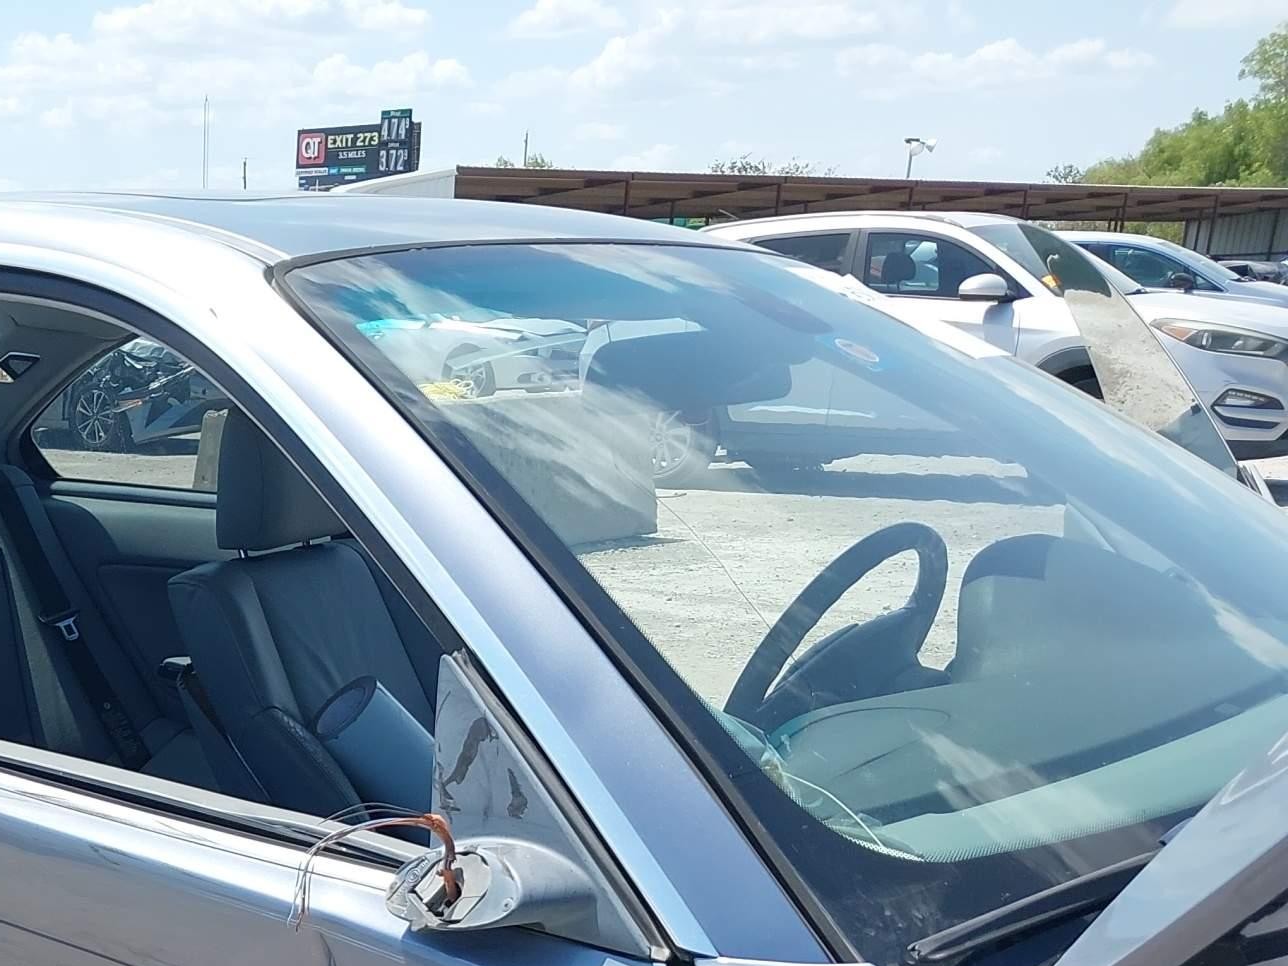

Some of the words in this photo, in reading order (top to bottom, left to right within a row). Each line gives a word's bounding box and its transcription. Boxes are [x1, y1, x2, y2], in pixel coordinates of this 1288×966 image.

[302, 138, 321, 159] QT
[327, 134, 354, 148] EXIT
[356, 132, 379, 146] 273
